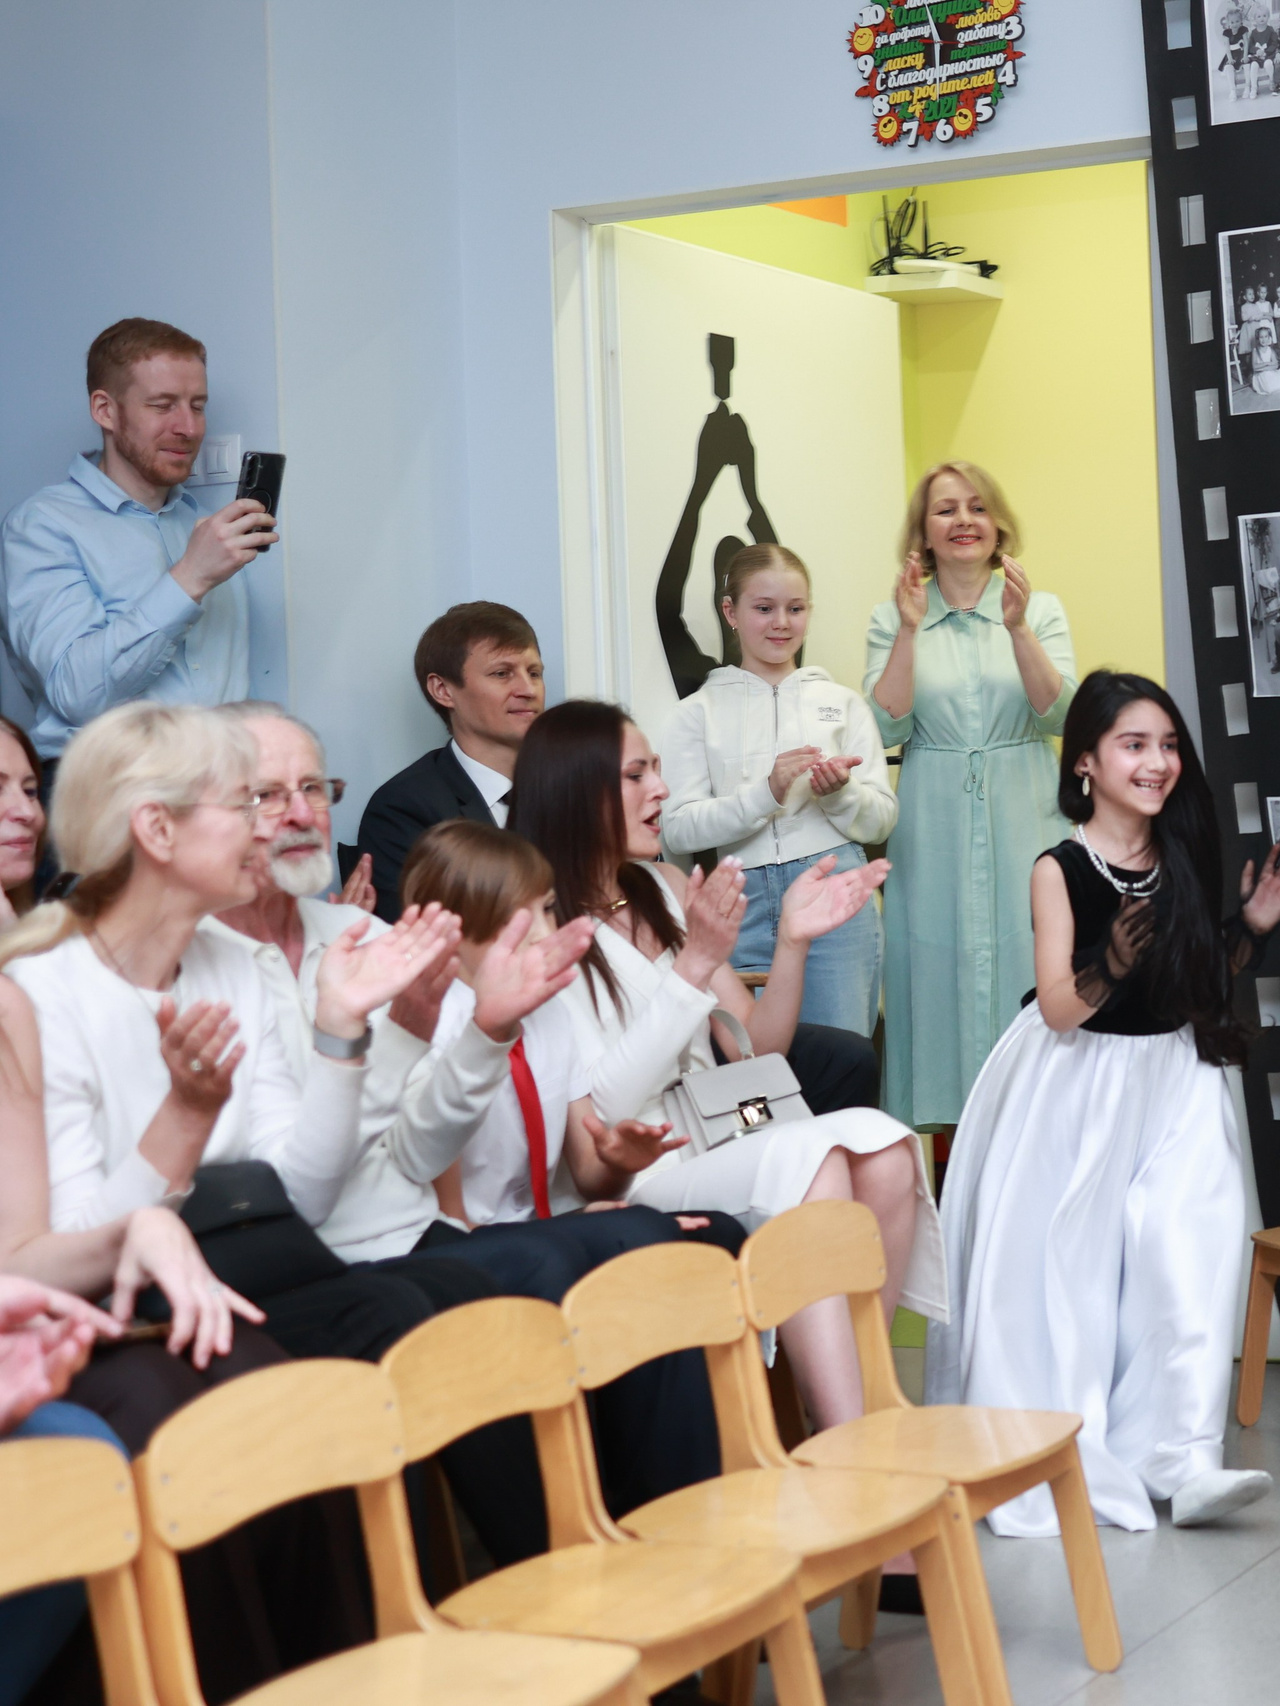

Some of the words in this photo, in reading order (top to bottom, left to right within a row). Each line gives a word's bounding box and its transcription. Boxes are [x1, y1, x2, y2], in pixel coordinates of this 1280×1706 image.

[858, 4, 885, 27] 10
[955, 6, 1001, 29] любовь
[875, 36, 889, 48] за
[889, 25, 931, 45] доброту
[957, 23, 1007, 48] заботу
[1004, 16, 1023, 40] 3
[950, 40, 1008, 60] терпение
[857, 55, 874, 78] 9
[884, 53, 925, 72] ласку
[998, 61, 1016, 85] 4
[889, 89, 912, 104] от
[913, 69, 996, 104] родителей
[873, 95, 890, 117] 8
[976, 97, 994, 122] 5
[902, 121, 919, 146] 7
[936, 119, 953, 141] 6
